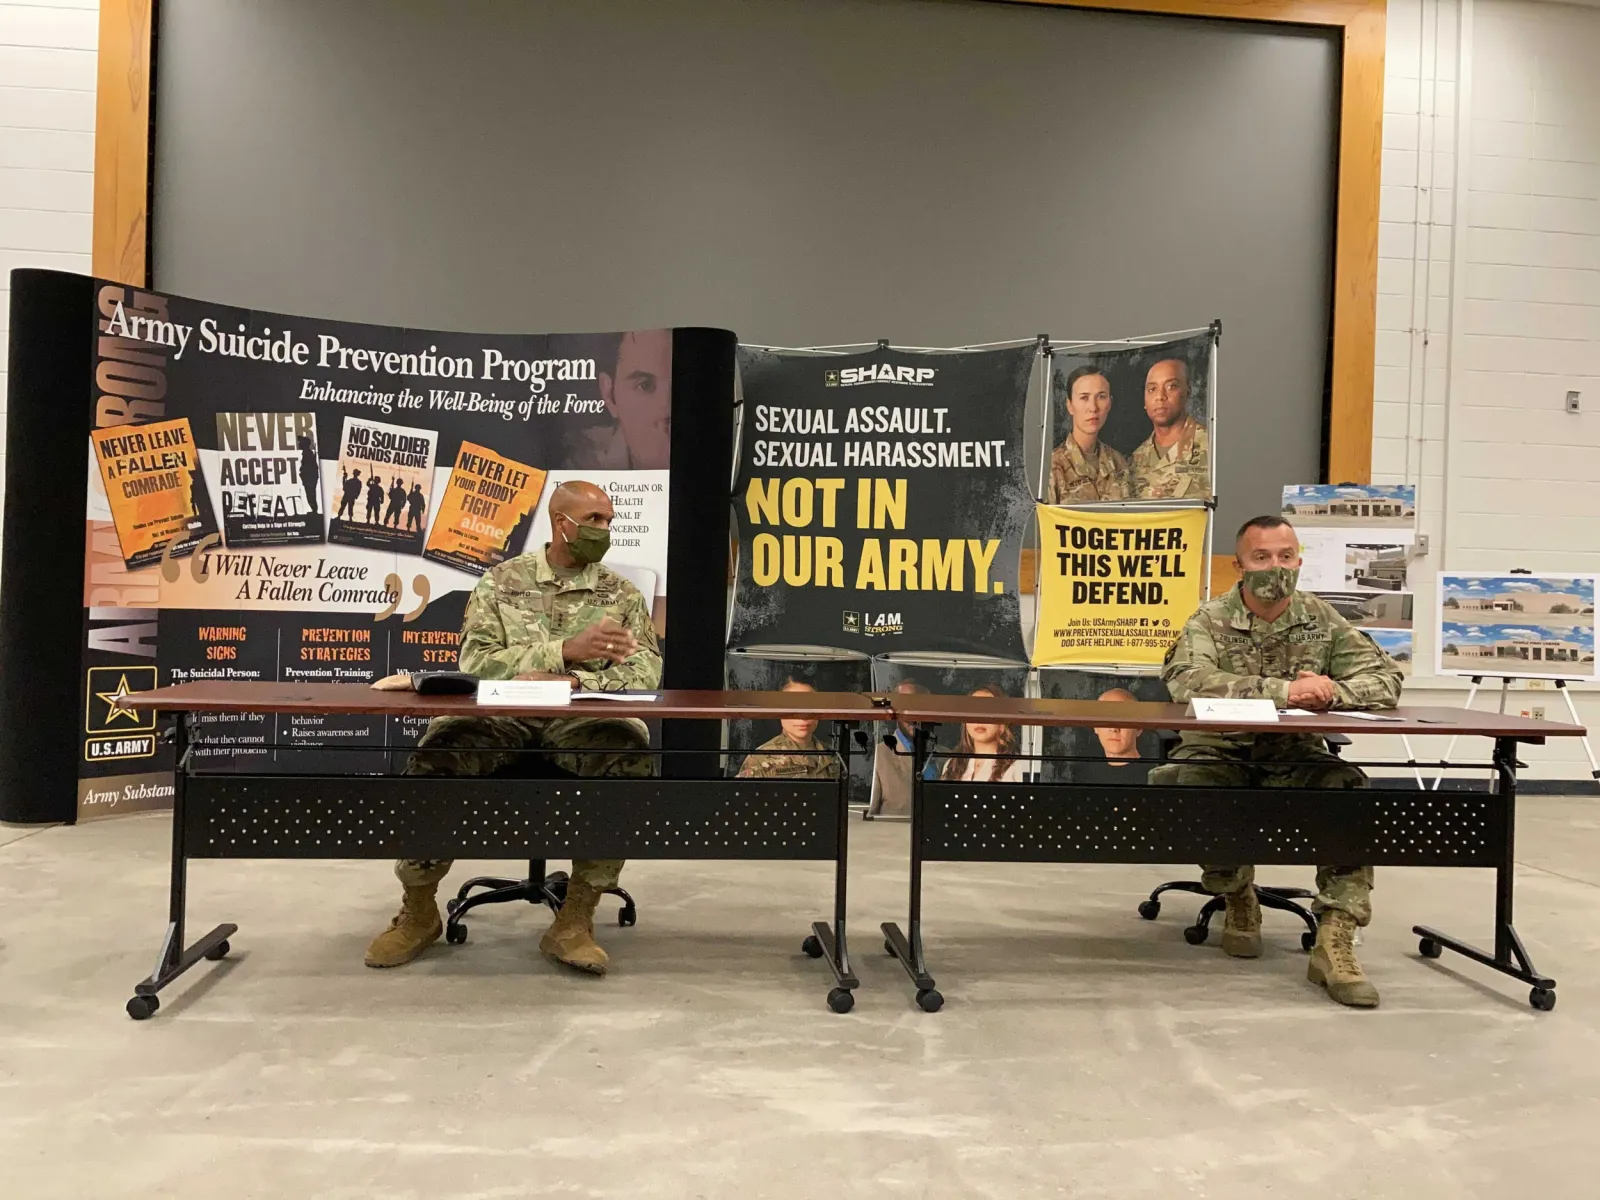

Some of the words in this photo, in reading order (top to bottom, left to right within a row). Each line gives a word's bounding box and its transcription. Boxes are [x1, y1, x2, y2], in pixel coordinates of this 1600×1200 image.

[104, 300, 193, 360] Army
[199, 318, 310, 366] Suicide
[317, 334, 475, 379] Prevention
[481, 349, 597, 393] Program
[840, 363, 935, 384] SHARP
[300, 379, 395, 414] Enhancing
[398, 388, 424, 409] the
[429, 389, 515, 420] Well-Being
[519, 394, 538, 421] of
[538, 395, 560, 413] the
[564, 394, 605, 414] Force
[755, 404, 839, 434] SEXUAL
[844, 406, 951, 434] ASSAULT.
[216, 412, 313, 451] NEVER
[348, 426, 370, 447] NO
[371, 430, 430, 456] SOLDIER
[100, 433, 148, 459] NEVER
[151, 427, 188, 449] LEAVE
[346, 444, 392, 464] STANDS
[392, 450, 428, 470] ALONE
[753, 440, 838, 467] SEXUAL
[843, 440, 1010, 468] HARASSMENT.
[107, 465, 117, 480] A
[116, 451, 188, 477] FALLEN
[221, 457, 299, 486] ACCEPT
[458, 451, 505, 482] NEVER
[506, 465, 530, 490] LET
[122, 470, 183, 499] COMRADE
[454, 474, 477, 496] YOUR
[477, 480, 518, 505] BUDDY
[609, 482, 650, 493] CHAPLAIN
[651, 483, 664, 492] OR
[222, 490, 301, 518] DEFEAT
[460, 493, 501, 521] FIGHT
[610, 495, 643, 506] HEALTH
[745, 477, 846, 528] NOT
[856, 478, 908, 530] IN
[634, 511, 642, 520] IF
[461, 514, 504, 540] alone
[610, 538, 641, 547] OLDIER
[1055, 524, 1188, 552] TOGETHER,
[200, 554, 213, 575] I
[216, 553, 255, 577] Will
[256, 556, 312, 579] Never
[315, 559, 369, 581] Leave
[752, 533, 845, 588] OUR
[855, 538, 1004, 595] ARMY.
[1056, 552, 1112, 578] THIS
[1117, 554, 1186, 578] WE'LL
[235, 580, 252, 600] A
[257, 579, 316, 602] Fallen
[317, 582, 399, 606] Comrade
[600, 598, 620, 606] ARMY
[1072, 581, 1169, 606] DEFEND.
[1067, 618, 1081, 627] Join
[1082, 617, 1092, 627] Us:
[1093, 617, 1138, 628] USArmySHARP
[198, 626, 246, 642] WARNING
[302, 628, 371, 643] PREVENTION
[1061, 638, 1075, 648] DOD
[1076, 638, 1092, 647] SAFE
[1093, 638, 1125, 647] HELPLINE:
[1306, 633, 1325, 641] ARMY
[206, 645, 237, 661] SIGNS
[300, 647, 371, 662] STRATEGIES
[423, 649, 458, 663] STEPS
[171, 668, 189, 678] The
[190, 667, 225, 678] Suicidal
[226, 667, 261, 678] Person:
[285, 666, 332, 677] Prevention
[334, 667, 374, 680] Training:
[201, 713, 218, 723] miss
[219, 712, 239, 722] them
[240, 711, 248, 721] if
[248, 711, 265, 724] they
[291, 715, 324, 725] behavior
[402, 715, 417, 725] Get
[204, 735, 219, 745] that
[220, 735, 237, 746] they
[237, 735, 265, 744] cannot
[291, 727, 316, 737] Raises
[316, 728, 356, 737] awareness
[356, 727, 369, 737] and
[403, 728, 418, 739] help
[195, 747, 211, 757] with
[213, 747, 230, 756] their
[83, 788, 119, 807] Army
